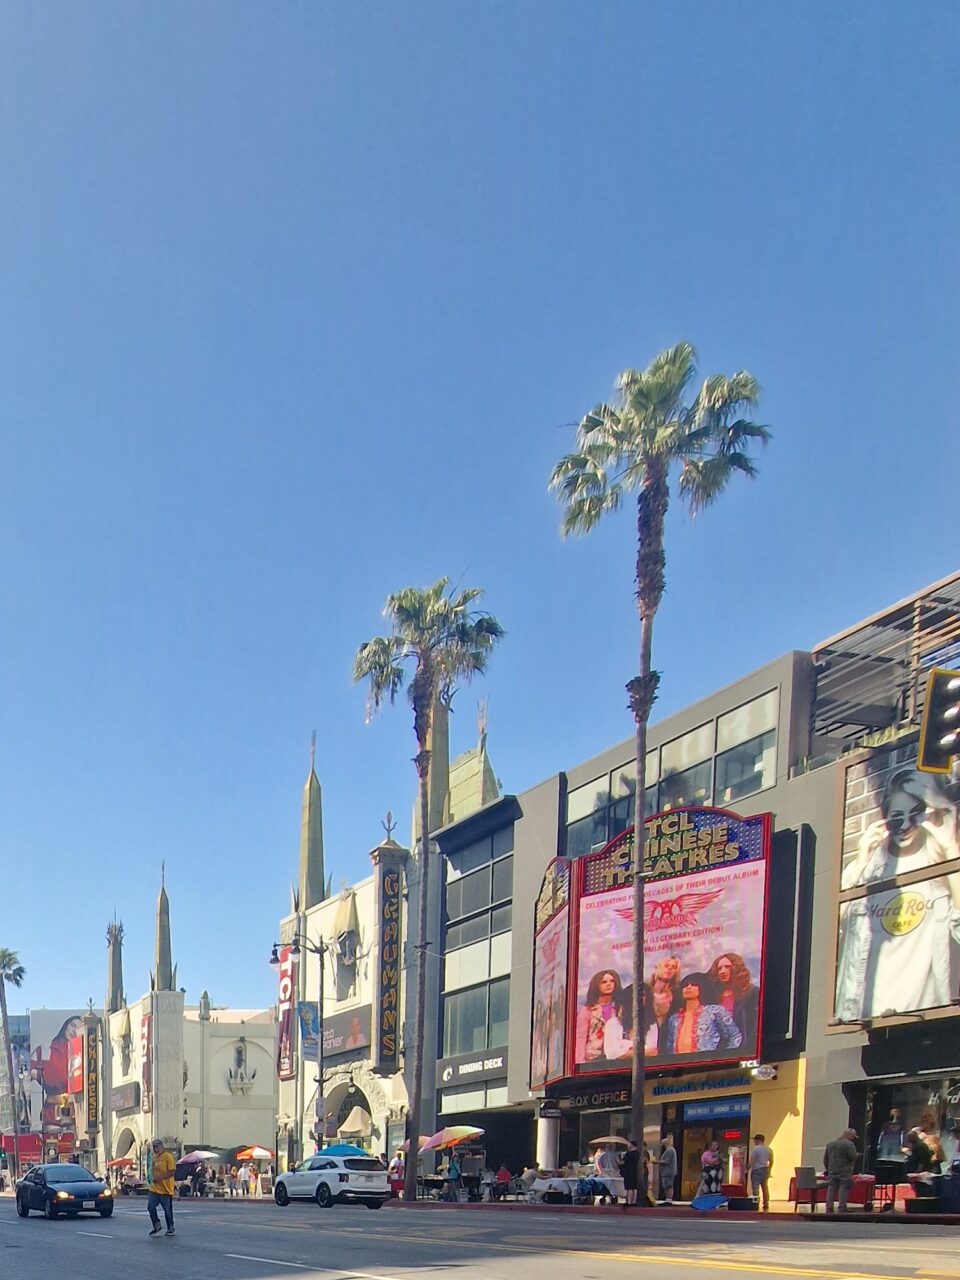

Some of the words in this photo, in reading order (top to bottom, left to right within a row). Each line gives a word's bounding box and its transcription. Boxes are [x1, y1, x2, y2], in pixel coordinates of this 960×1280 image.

[645, 811, 695, 838] TCL
[613, 823, 728, 865] CHINESE
[675, 883, 684, 892] OF
[686, 879, 706, 889] THEIR
[708, 874, 732, 886] DEBUT
[733, 869, 759, 880] ALBUM
[279, 951, 293, 1022] TCL
[458, 1060, 482, 1075] DINING
[484, 1056, 504, 1071] DECK
[740, 1060, 759, 1068] TCL
[88, 1034, 97, 1121] CHINESE
[592, 1090, 628, 1105] OFFICE
[927, 1091, 960, 1106] Hrd
